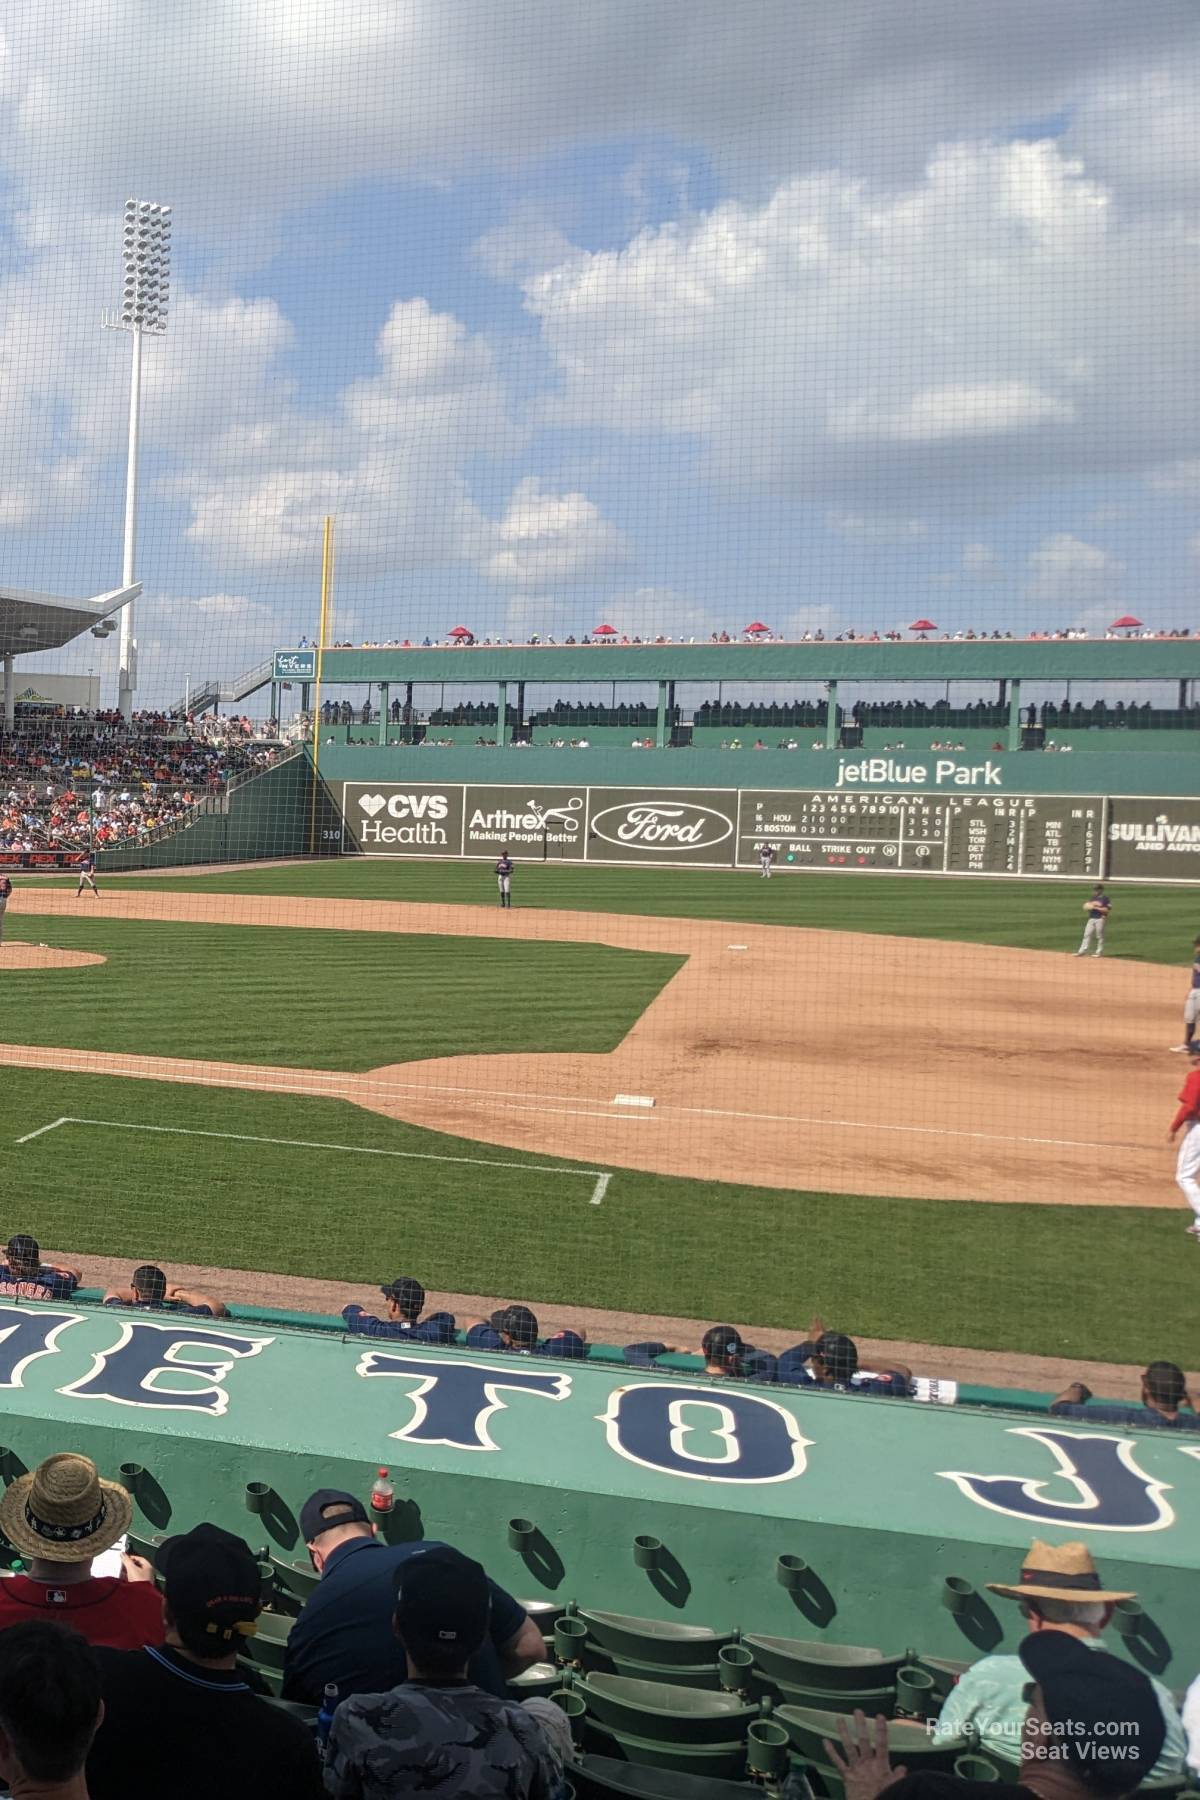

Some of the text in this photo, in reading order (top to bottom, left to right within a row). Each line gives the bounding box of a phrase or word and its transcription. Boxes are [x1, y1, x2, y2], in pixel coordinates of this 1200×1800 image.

[835, 758, 1002, 787] jetBlue Park
[387, 794, 448, 819] CVS
[811, 795, 1035, 807] AMERICAN LEAGUE
[756, 803, 763, 811] P
[830, 805, 837, 813] 4
[840, 805, 847, 813] 5
[870, 806, 876, 814] 8
[878, 806, 885, 814] 9
[889, 806, 899, 814] 10
[908, 806, 916, 814] R
[922, 807, 929, 815] H
[936, 807, 942, 815] E
[954, 807, 962, 815] P
[994, 808, 1004, 816] IN
[1072, 810, 1082, 818] IN
[1086, 810, 1094, 818] R
[469, 809, 549, 830] Arthrex
[618, 807, 706, 842] Ford
[773, 814, 792, 822] HOU
[840, 816, 846, 824] 0
[908, 818, 915, 826] 3
[935, 818, 941, 826] 0
[323, 830, 340, 840] 310
[360, 820, 448, 844] Health
[469, 830, 578, 843] Making People Better
[764, 825, 796, 833] BOSTON
[818, 826, 824, 834] 0
[934, 829, 940, 837] 0
[789, 844, 812, 852] BALL
[821, 844, 851, 854] STRIKE
[856, 846, 876, 854] OUT
[1136, 842, 1200, 852] AND AUTO
[29, 854, 57, 864] DEX
[968, 862, 983, 870] PHI
[356, 1350, 816, 1485] TO
[935, 1425, 1200, 1532] J
